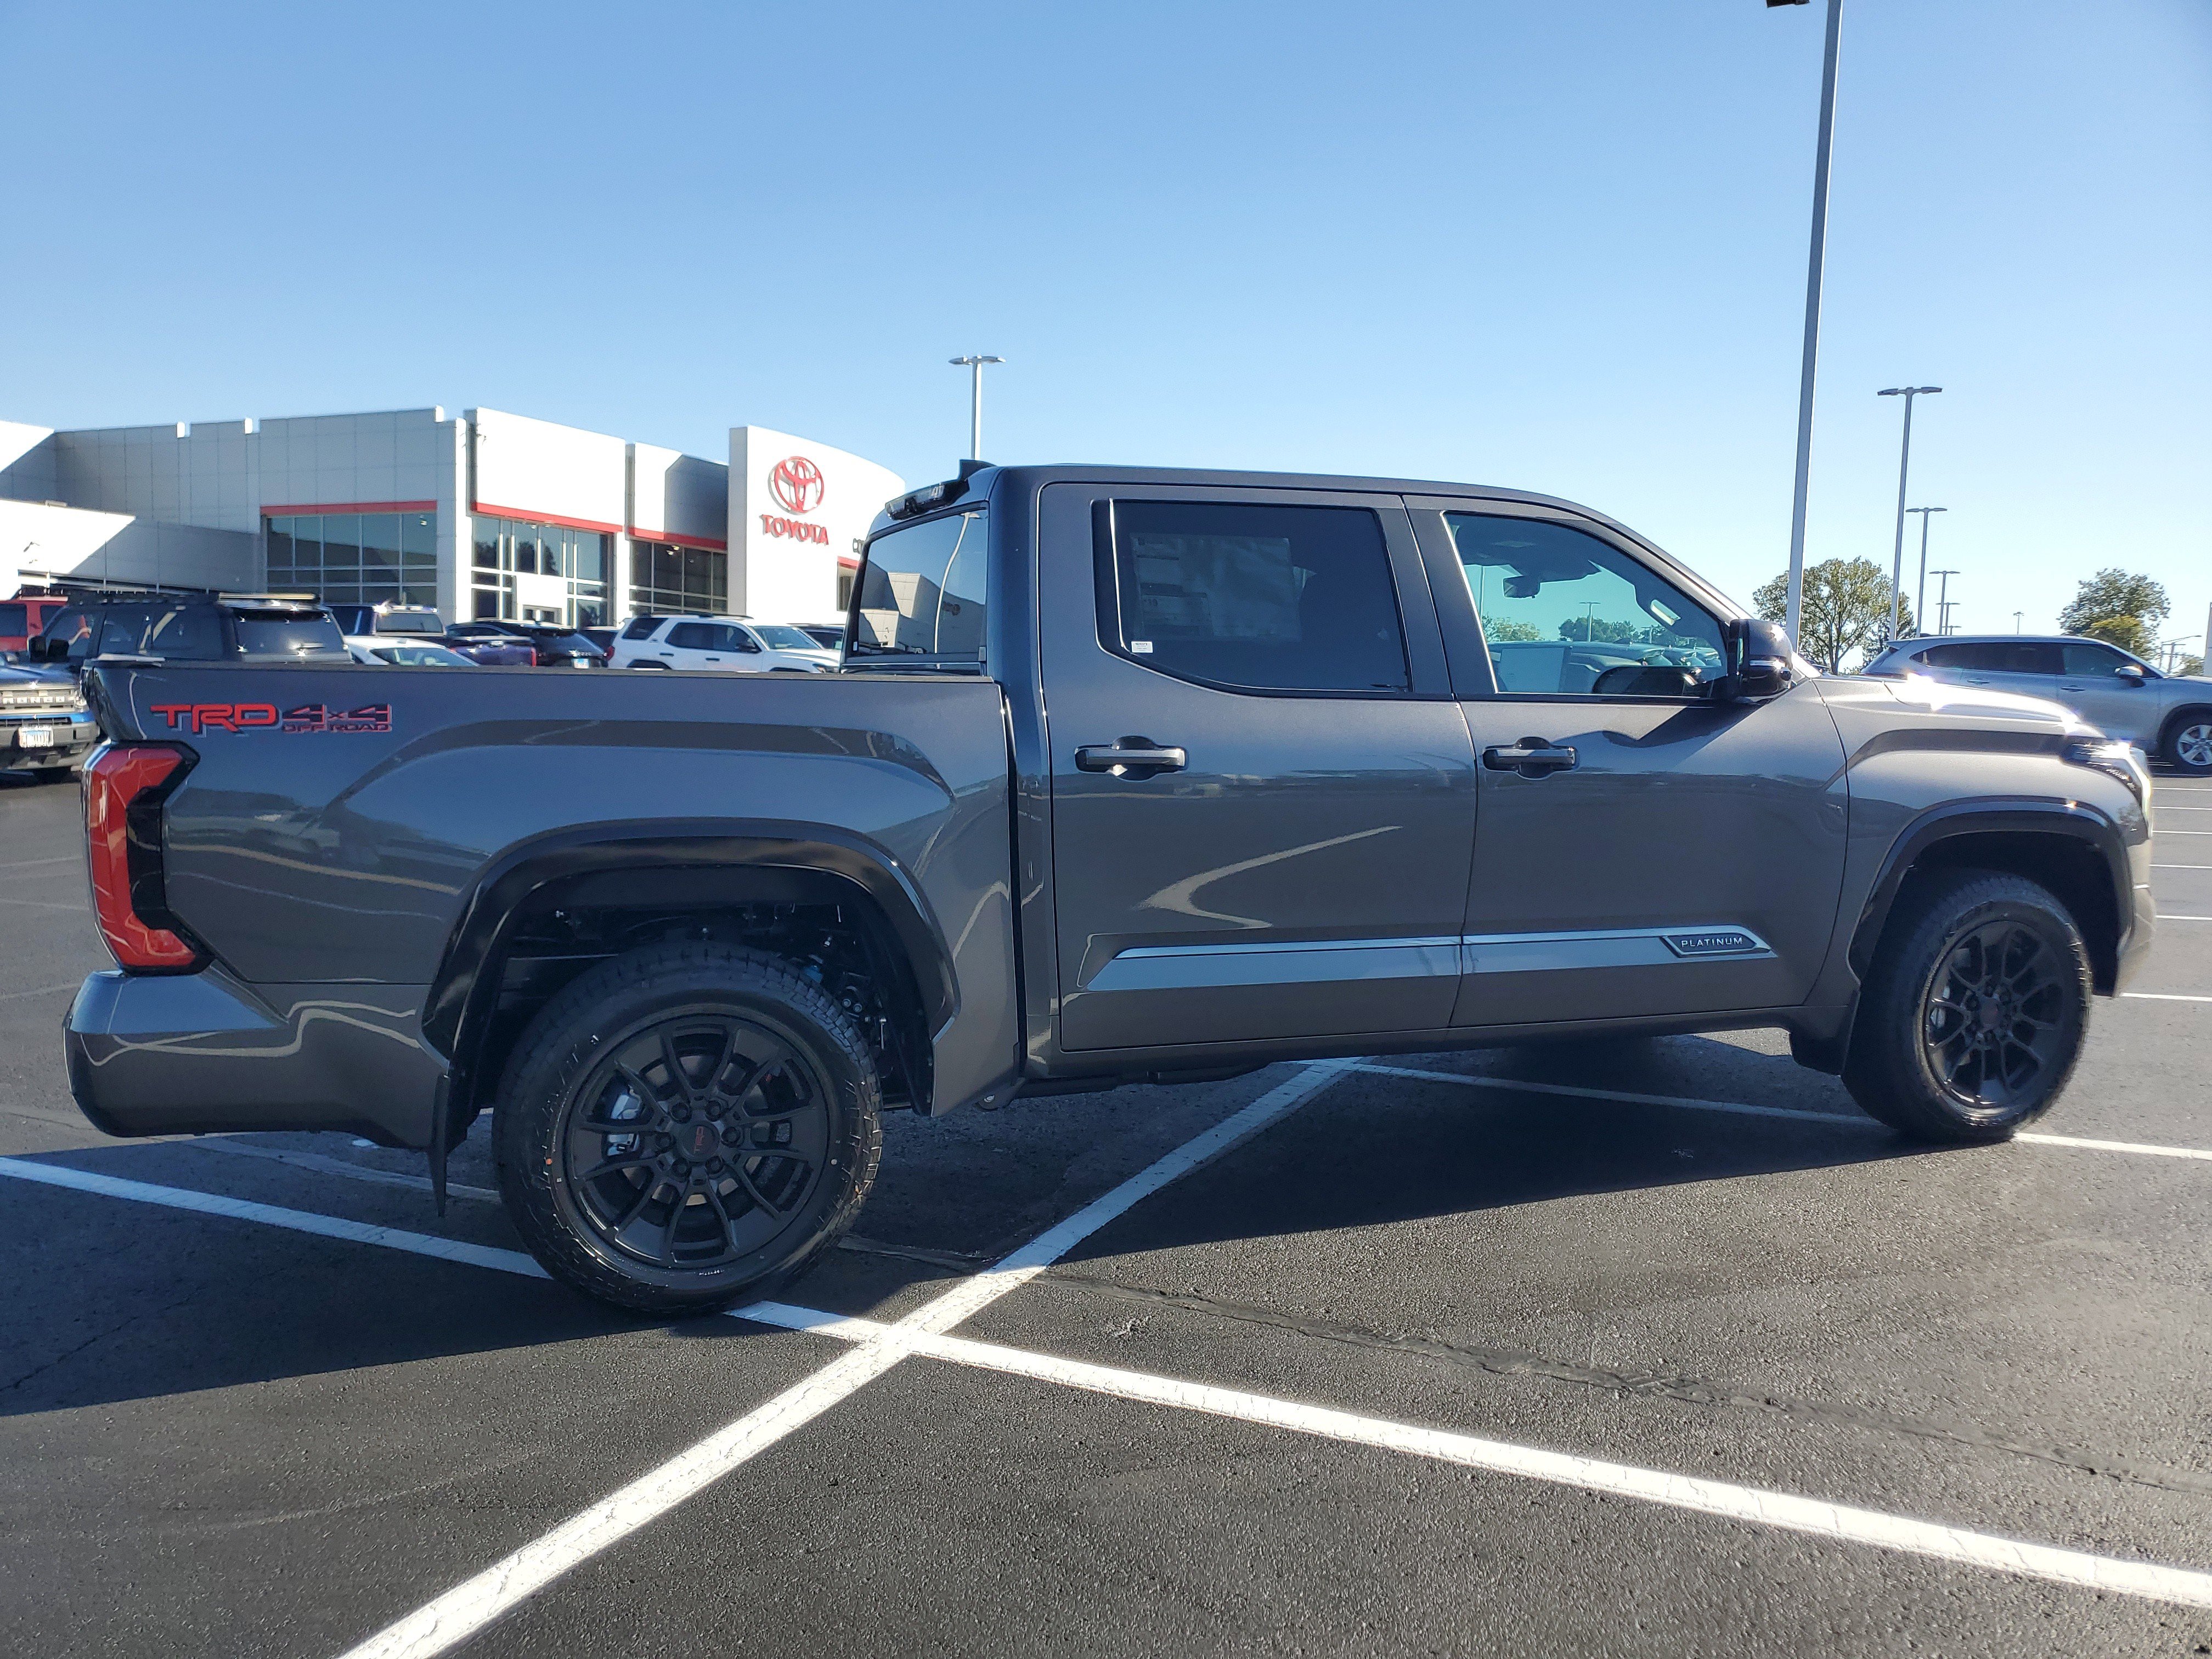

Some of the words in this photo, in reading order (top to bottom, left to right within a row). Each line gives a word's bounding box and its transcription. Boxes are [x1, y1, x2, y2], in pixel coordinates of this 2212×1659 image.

[759, 514, 829, 545] TOYOTA
[150, 704, 279, 733] TRD
[282, 724, 326, 732] OFF
[330, 724, 392, 732] ROAD
[1681, 937, 1743, 947] PLATINUM
[693, 1126, 704, 1154] TRD
